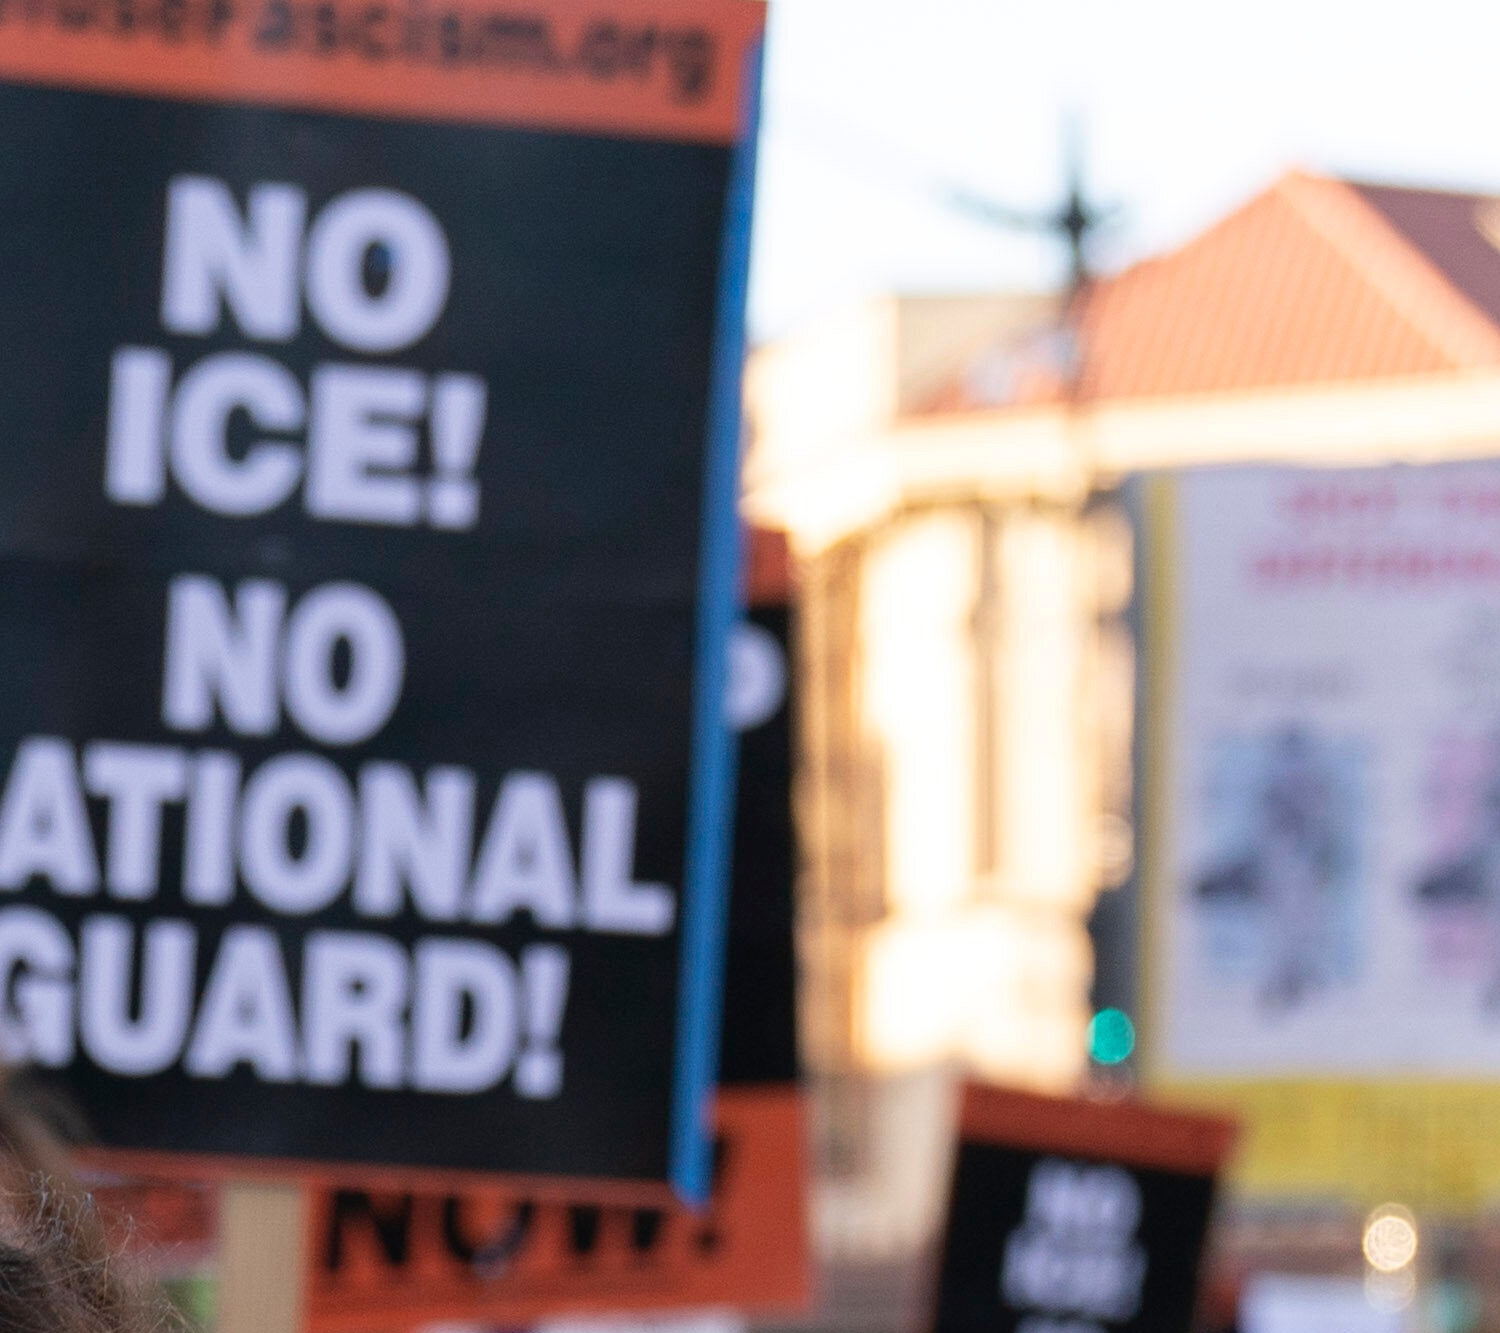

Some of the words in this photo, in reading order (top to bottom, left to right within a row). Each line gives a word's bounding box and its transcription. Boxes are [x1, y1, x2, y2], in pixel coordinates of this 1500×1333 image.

[161, 174, 452, 352] NO
[105, 346, 488, 531] ICE!
[163, 576, 405, 746] NO
